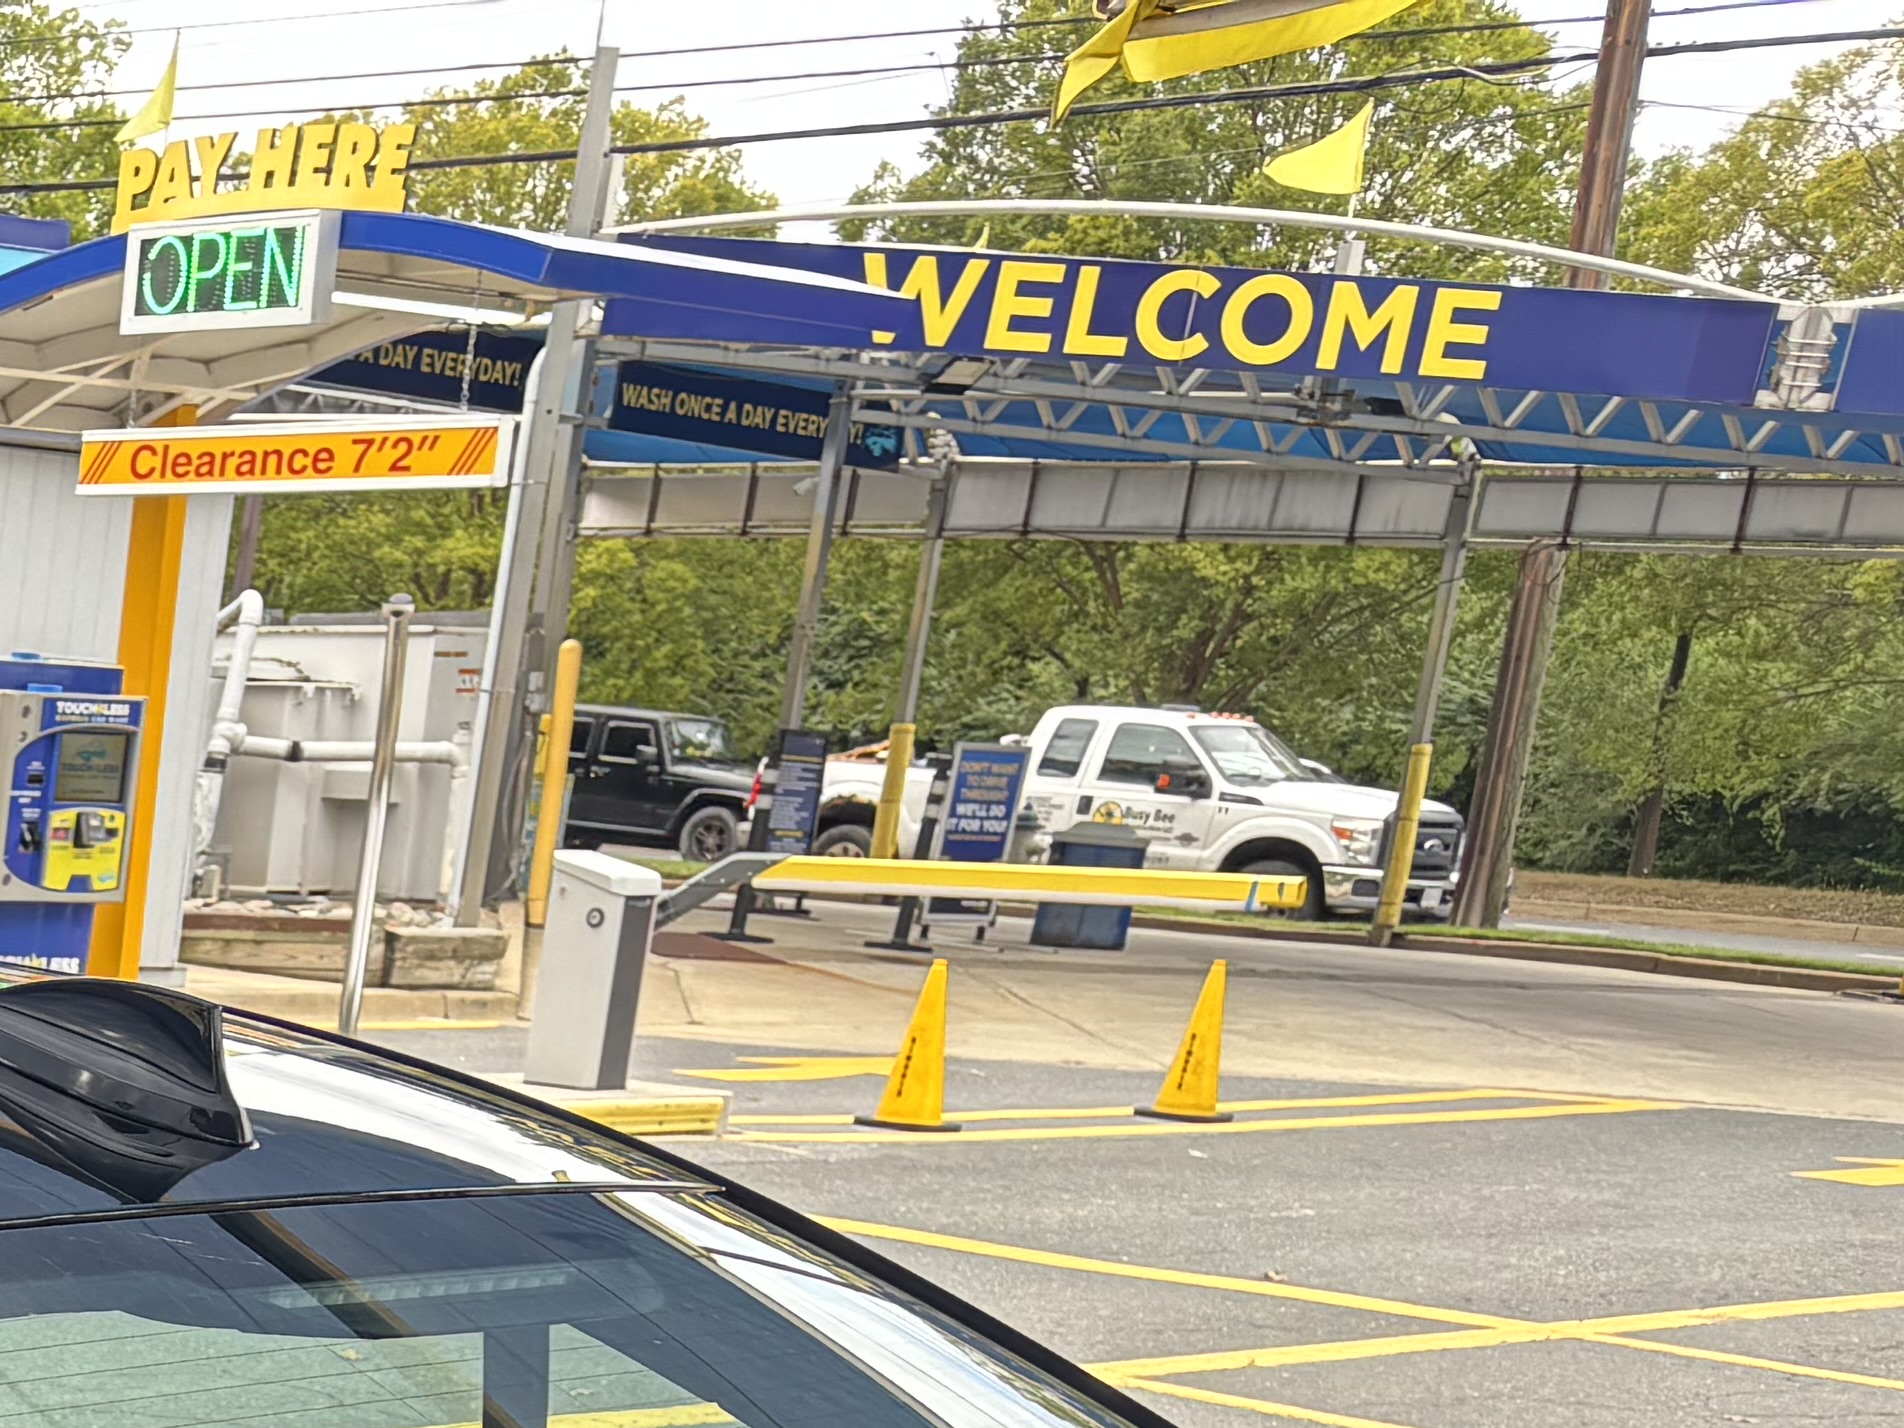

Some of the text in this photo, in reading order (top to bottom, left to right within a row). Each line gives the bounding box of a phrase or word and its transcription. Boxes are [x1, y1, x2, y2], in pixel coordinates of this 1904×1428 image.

[116, 123, 418, 214] PAY HERE
[141, 226, 306, 316] OPEN
[863, 252, 1503, 381] WELCOME
[379, 343, 419, 370] DAY
[621, 382, 864, 445] WASH ONCE A DAY EVERYY!
[128, 443, 336, 481] Clearance
[1153, 808, 1175, 823] Bee
